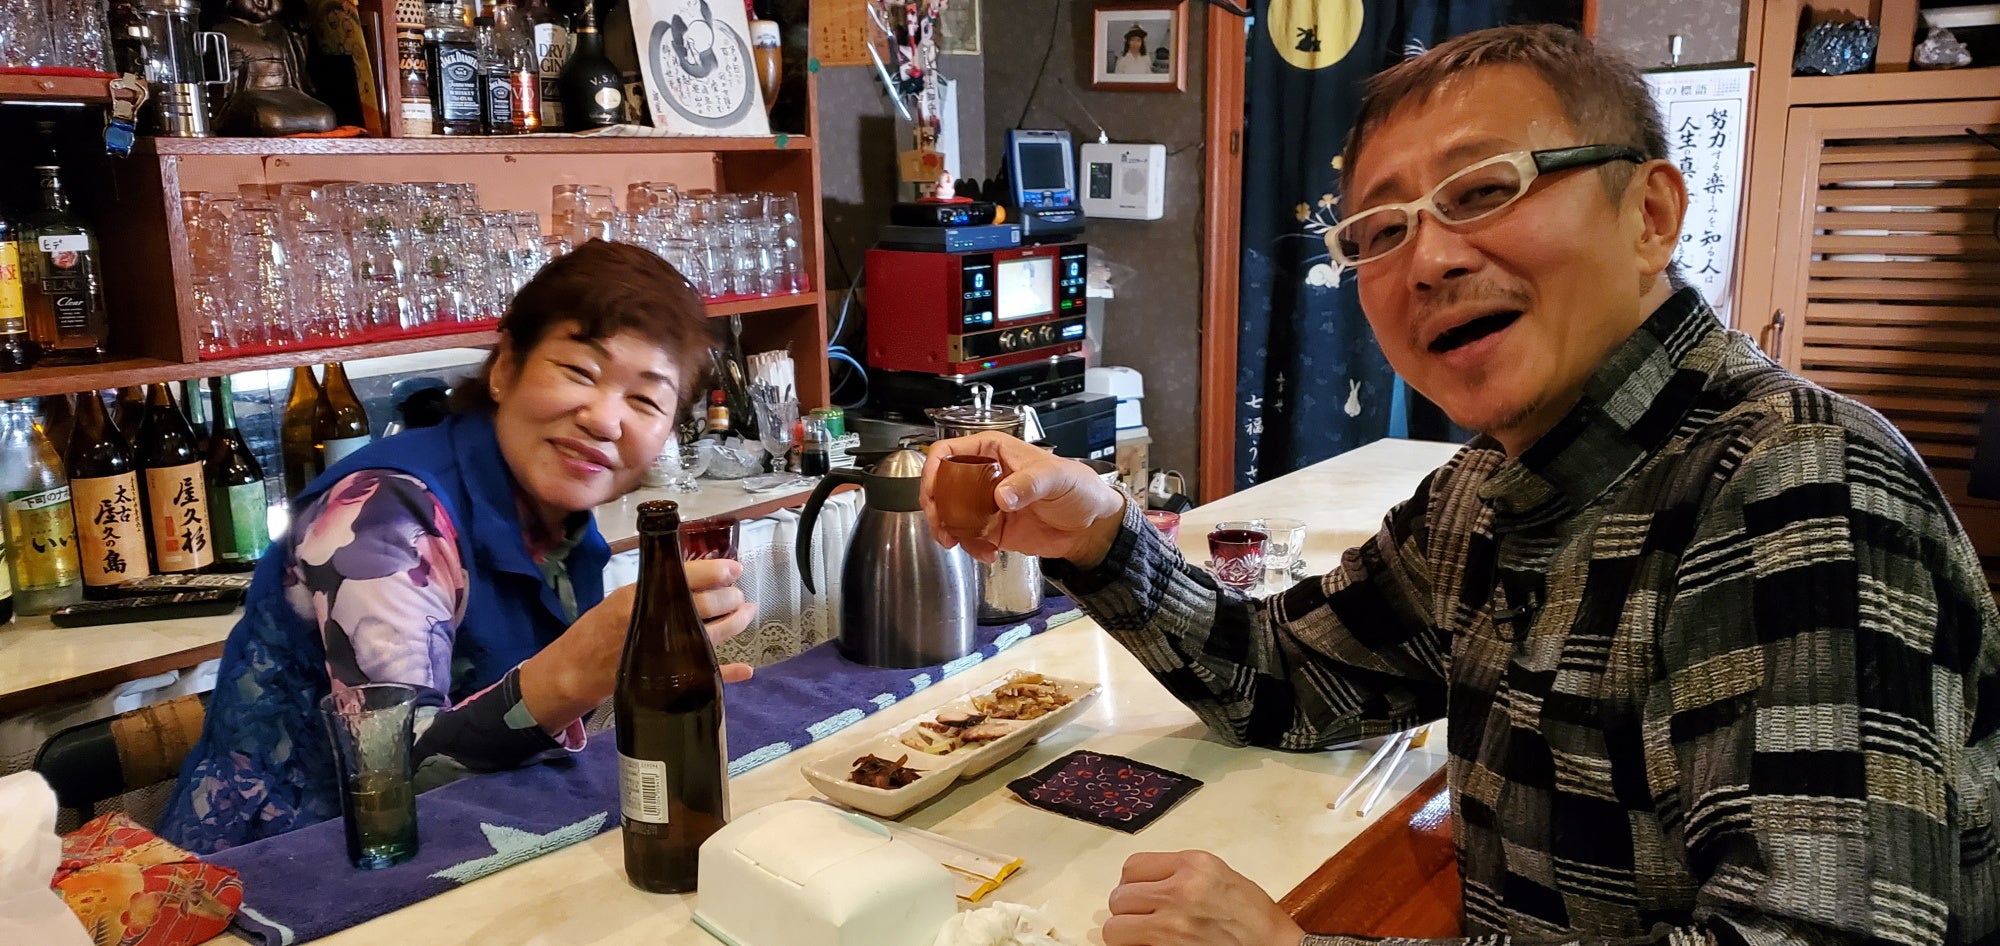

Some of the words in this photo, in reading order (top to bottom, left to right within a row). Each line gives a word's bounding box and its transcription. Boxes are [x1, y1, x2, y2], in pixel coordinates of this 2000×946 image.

[540, 43, 565, 58] DRY
[440, 54, 457, 69] JACK
[541, 58, 564, 73] GIN
[56, 296, 85, 307] Clear
[114, 484, 132, 523] 太古
[173, 476, 207, 554] 屋久杉
[94, 499, 127, 574] 屋久の島
